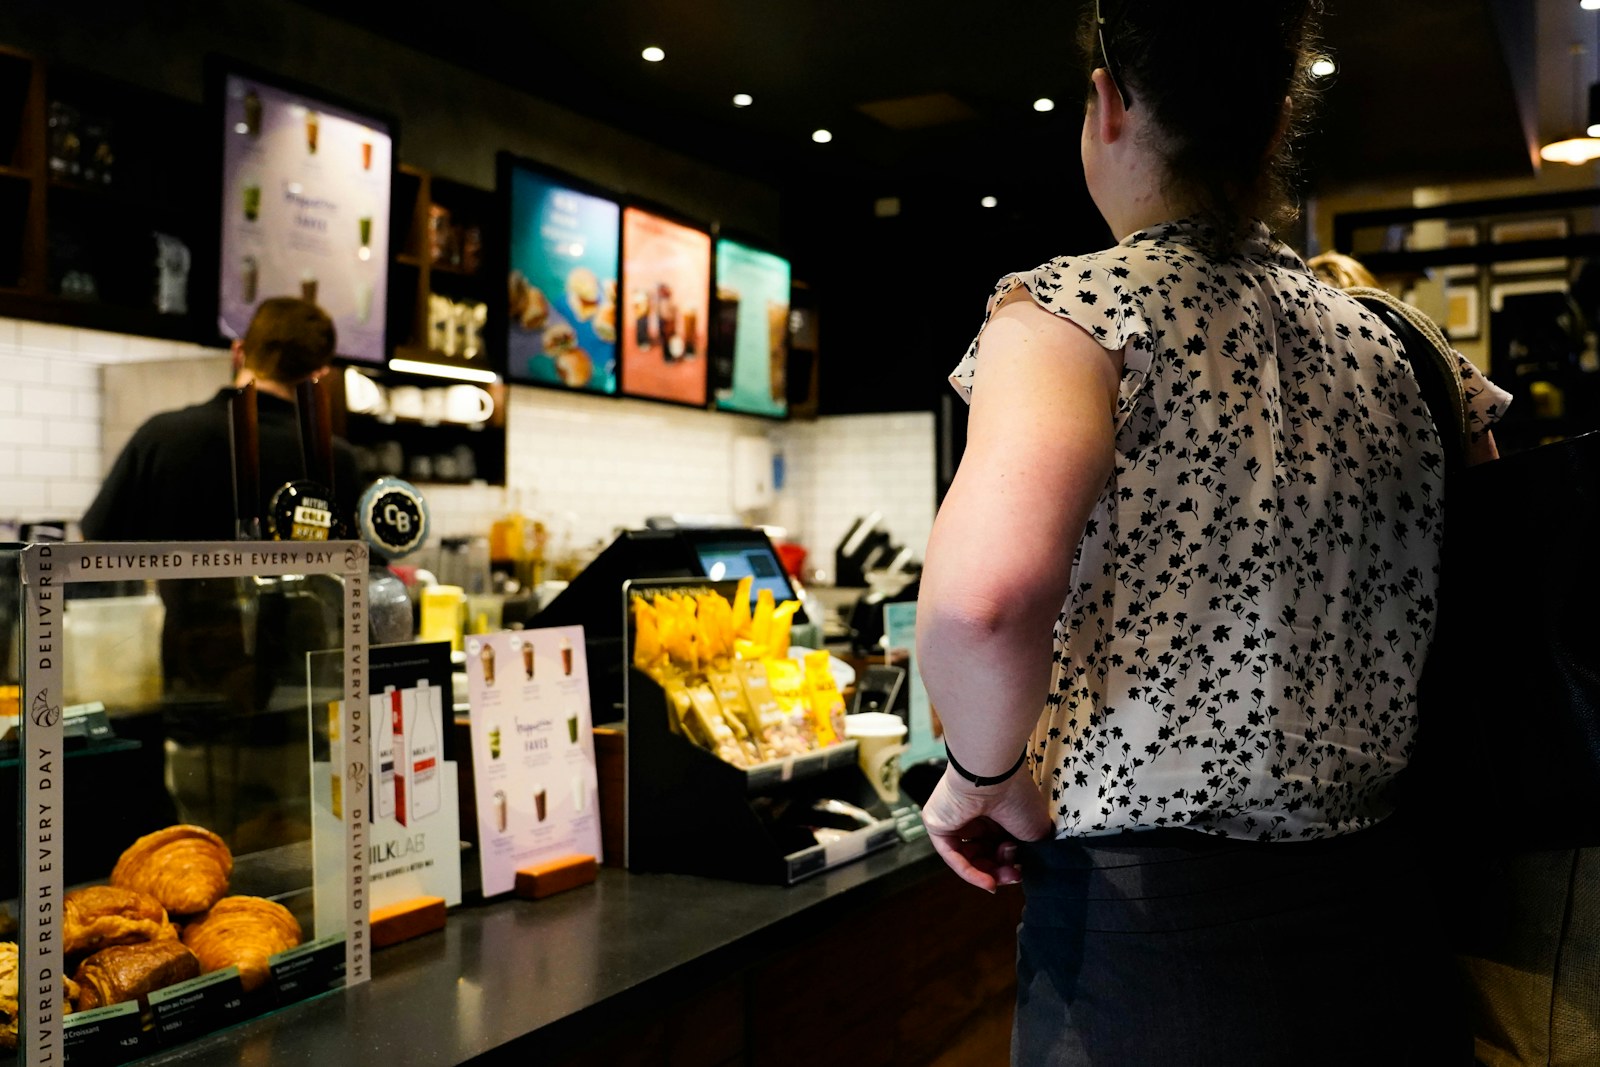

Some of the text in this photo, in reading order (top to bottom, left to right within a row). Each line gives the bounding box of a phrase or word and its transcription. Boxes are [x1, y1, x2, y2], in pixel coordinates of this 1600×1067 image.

[39, 546, 52, 669] DELIVERED
[81, 551, 333, 569] DELIVERED FRESH EVERY DAY
[352, 578, 361, 745] FRESH EVERY DAY
[39, 749, 52, 1067] LIVERED FRESH EVERY DAY
[352, 809, 363, 977] DELIVERED FRESH
[68, 1025, 99, 1039] Croissant
